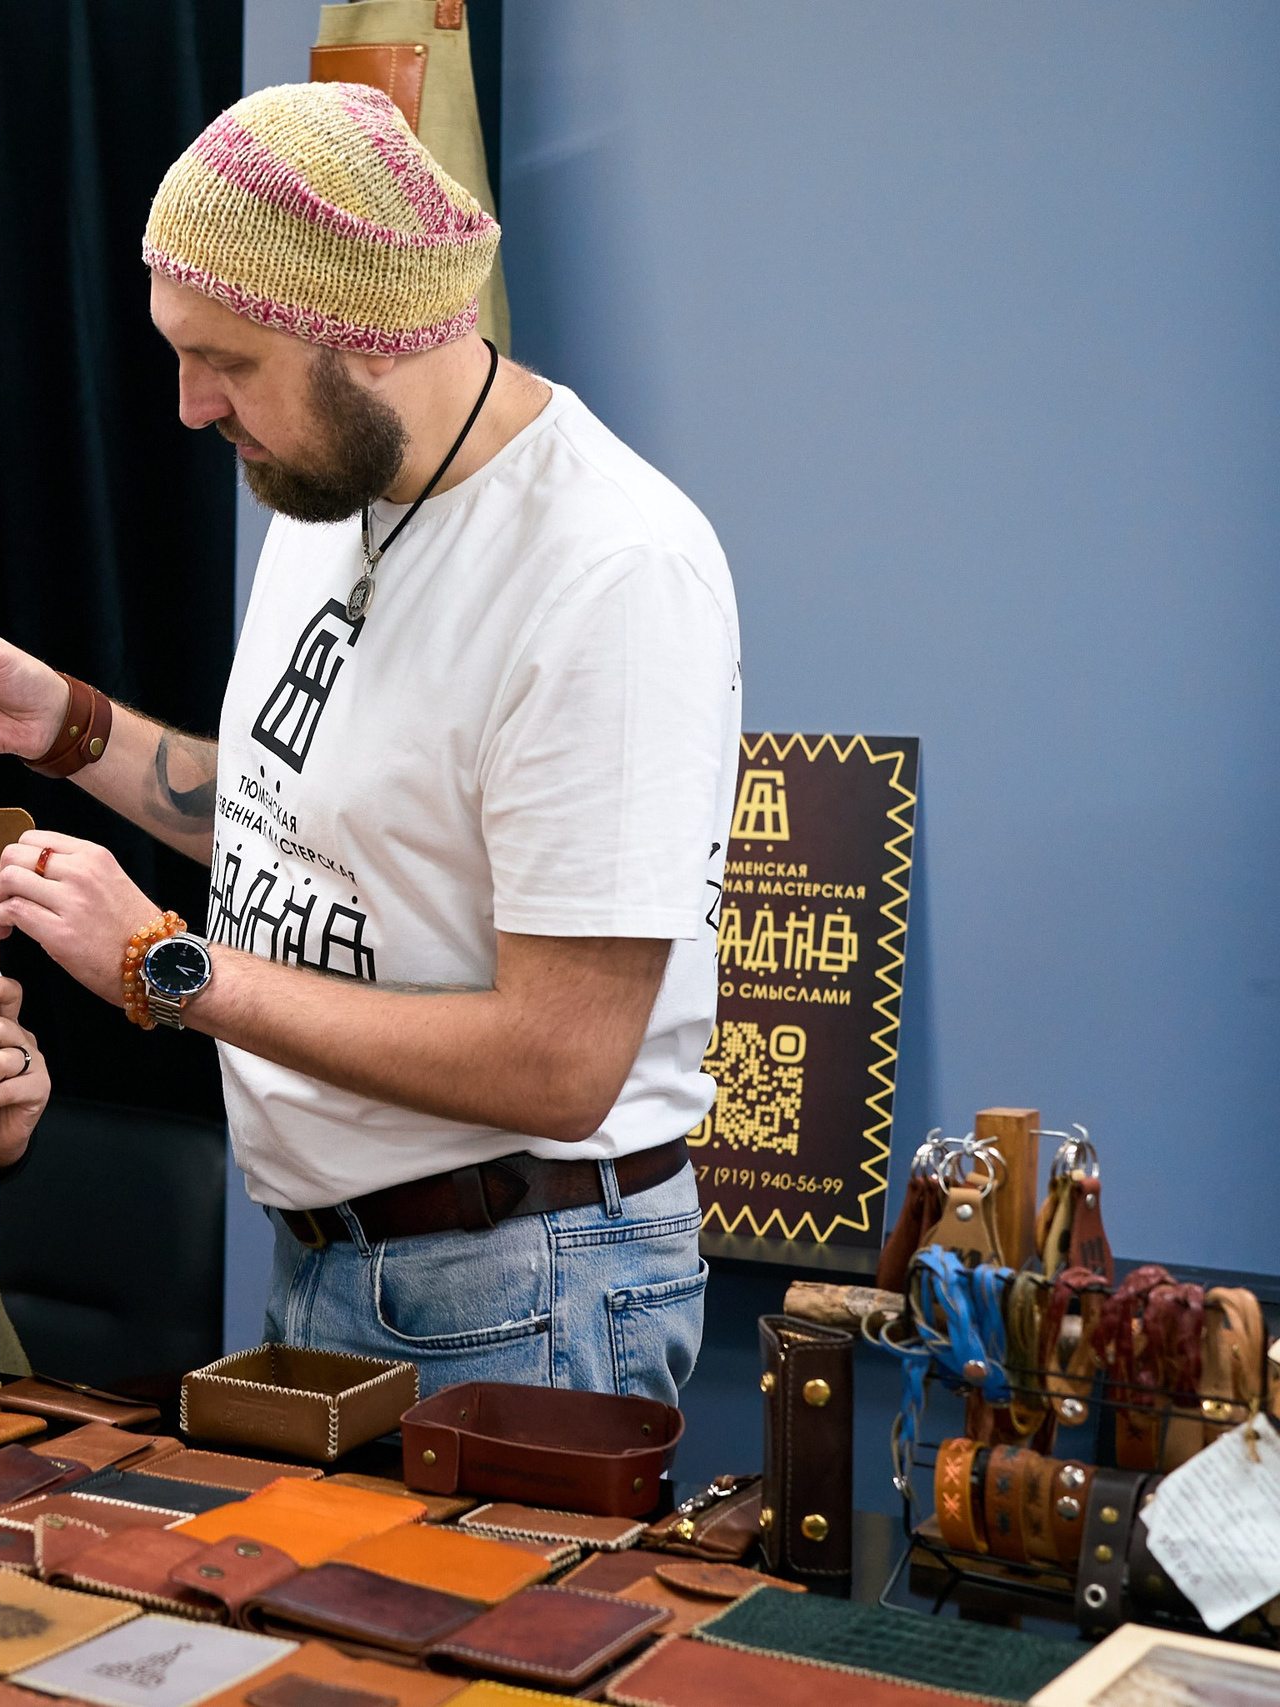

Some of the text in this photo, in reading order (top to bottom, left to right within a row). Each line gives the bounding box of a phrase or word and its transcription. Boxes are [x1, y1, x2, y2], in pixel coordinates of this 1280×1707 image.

[757, 880, 866, 901] МАСТЕРСКАЯ
[718, 981, 852, 1006] О СМЫСЛАМИ
[714, 1166, 756, 1191] (919)
[760, 1170, 844, 1196] 940-56-99
